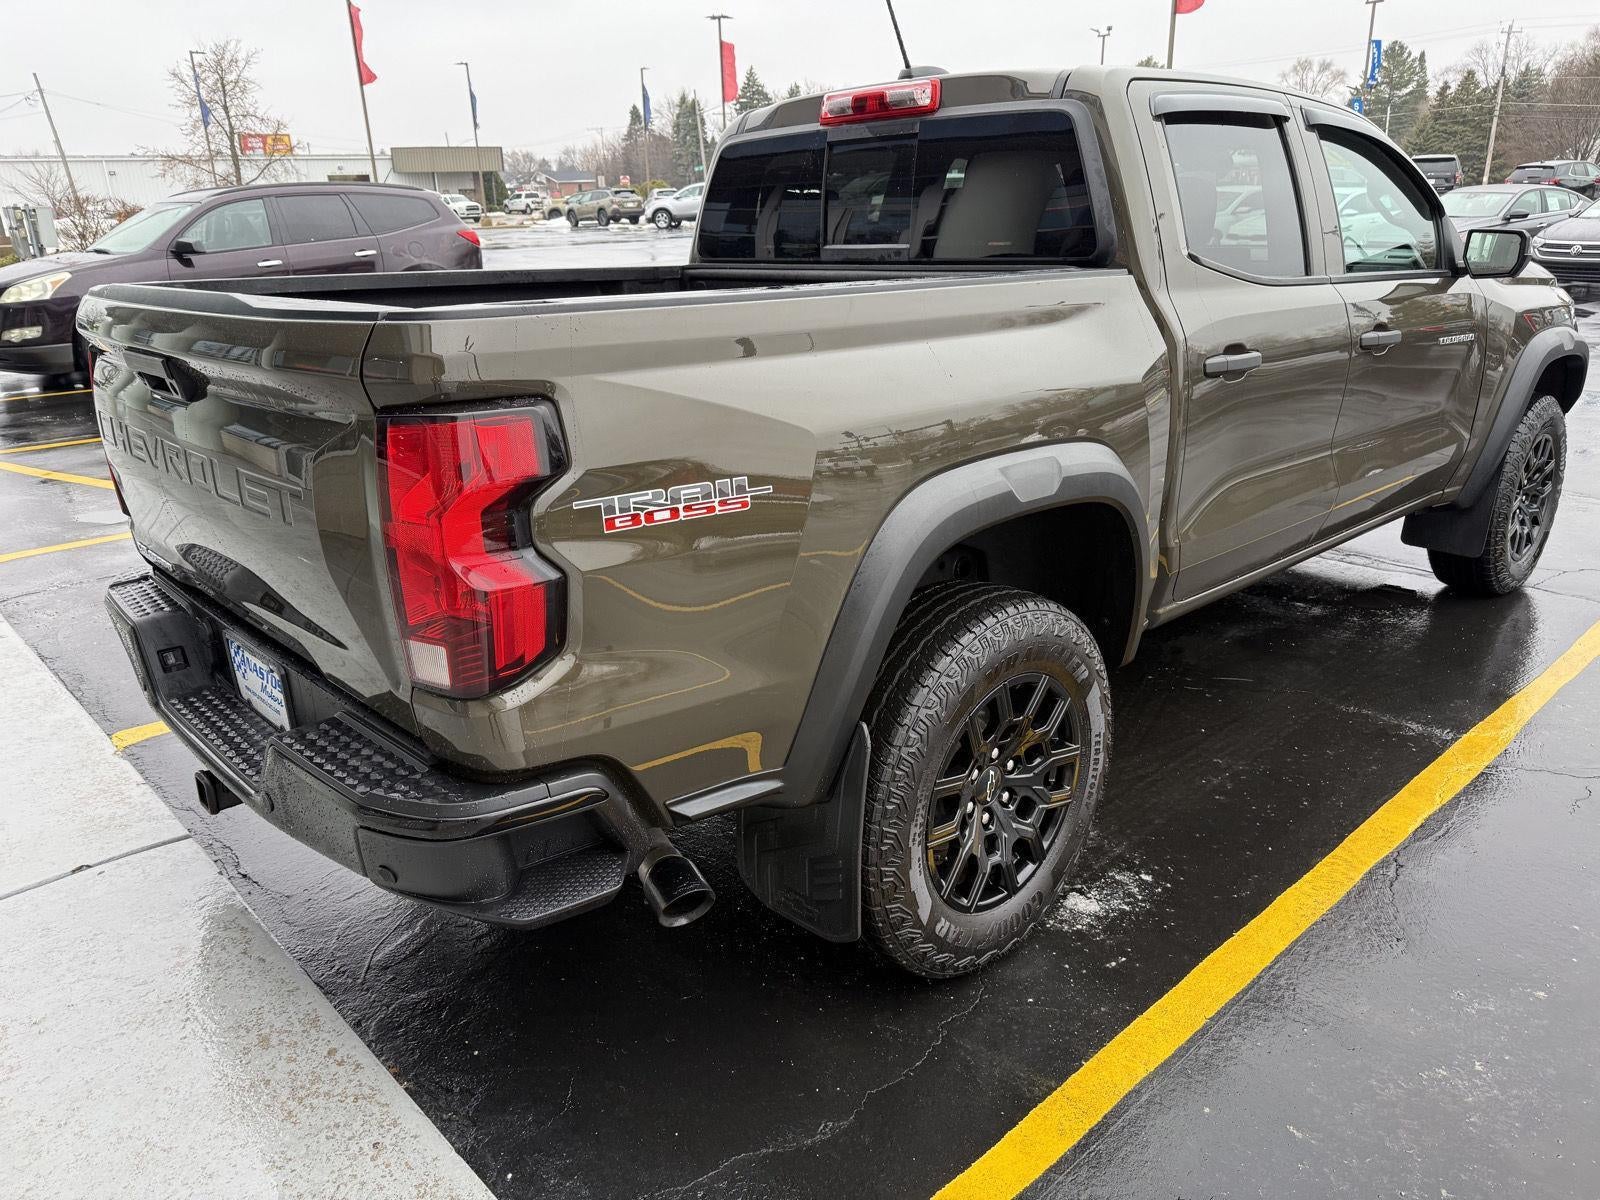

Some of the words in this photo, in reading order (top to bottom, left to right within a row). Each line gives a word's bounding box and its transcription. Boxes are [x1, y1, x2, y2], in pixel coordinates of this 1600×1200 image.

[98, 409, 304, 526] CHEVROLET
[573, 476, 773, 517] TRAIL
[603, 495, 751, 533] BOSS
